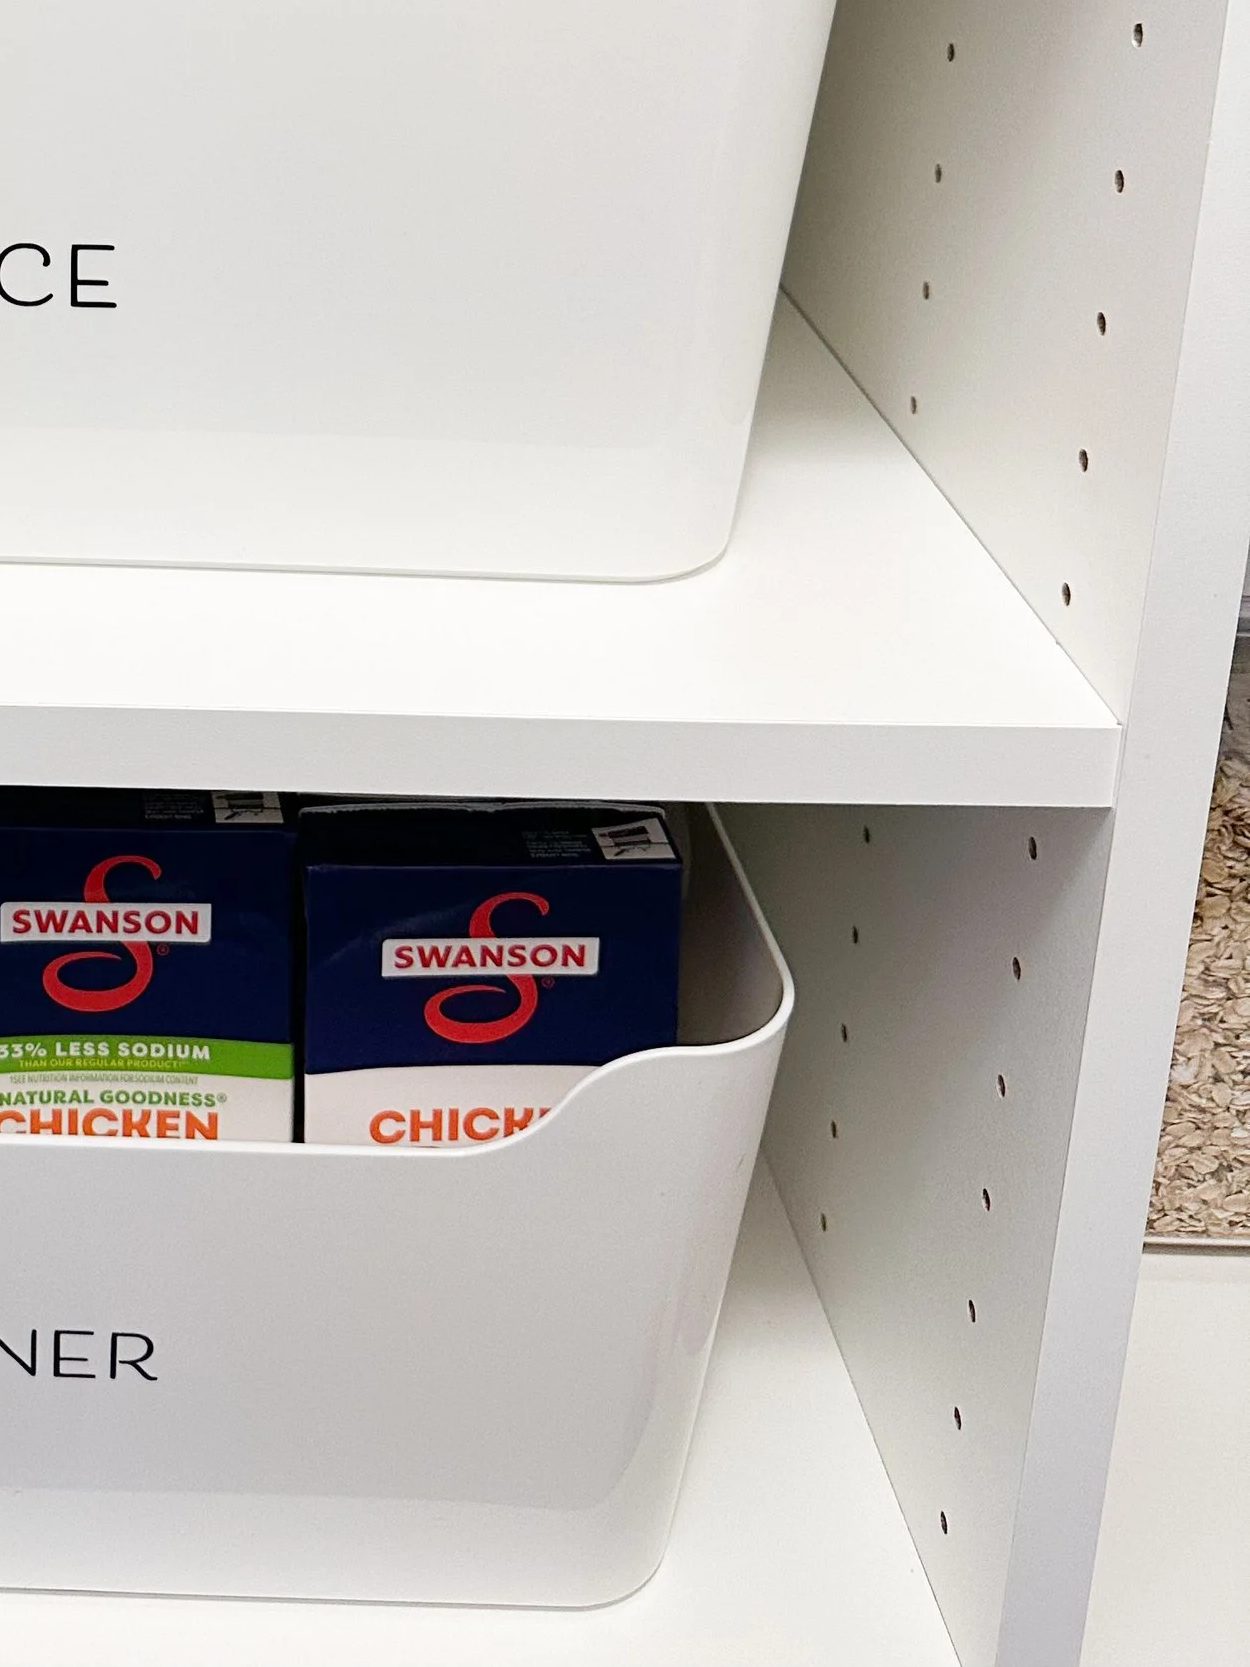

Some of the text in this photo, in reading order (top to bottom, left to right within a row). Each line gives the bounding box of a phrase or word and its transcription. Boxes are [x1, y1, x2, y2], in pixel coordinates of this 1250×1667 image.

[12, 908, 199, 935] SWANSON
[393, 943, 586, 969] SWANSON
[19, 1059, 48, 1069] THAN
[50, 1058, 73, 1068] OUR
[75, 1058, 125, 1068] REGULAR
[55, 1041, 110, 1057] LESS
[118, 1042, 211, 1060] SODIUM
[369, 1107, 552, 1144] CHICK
